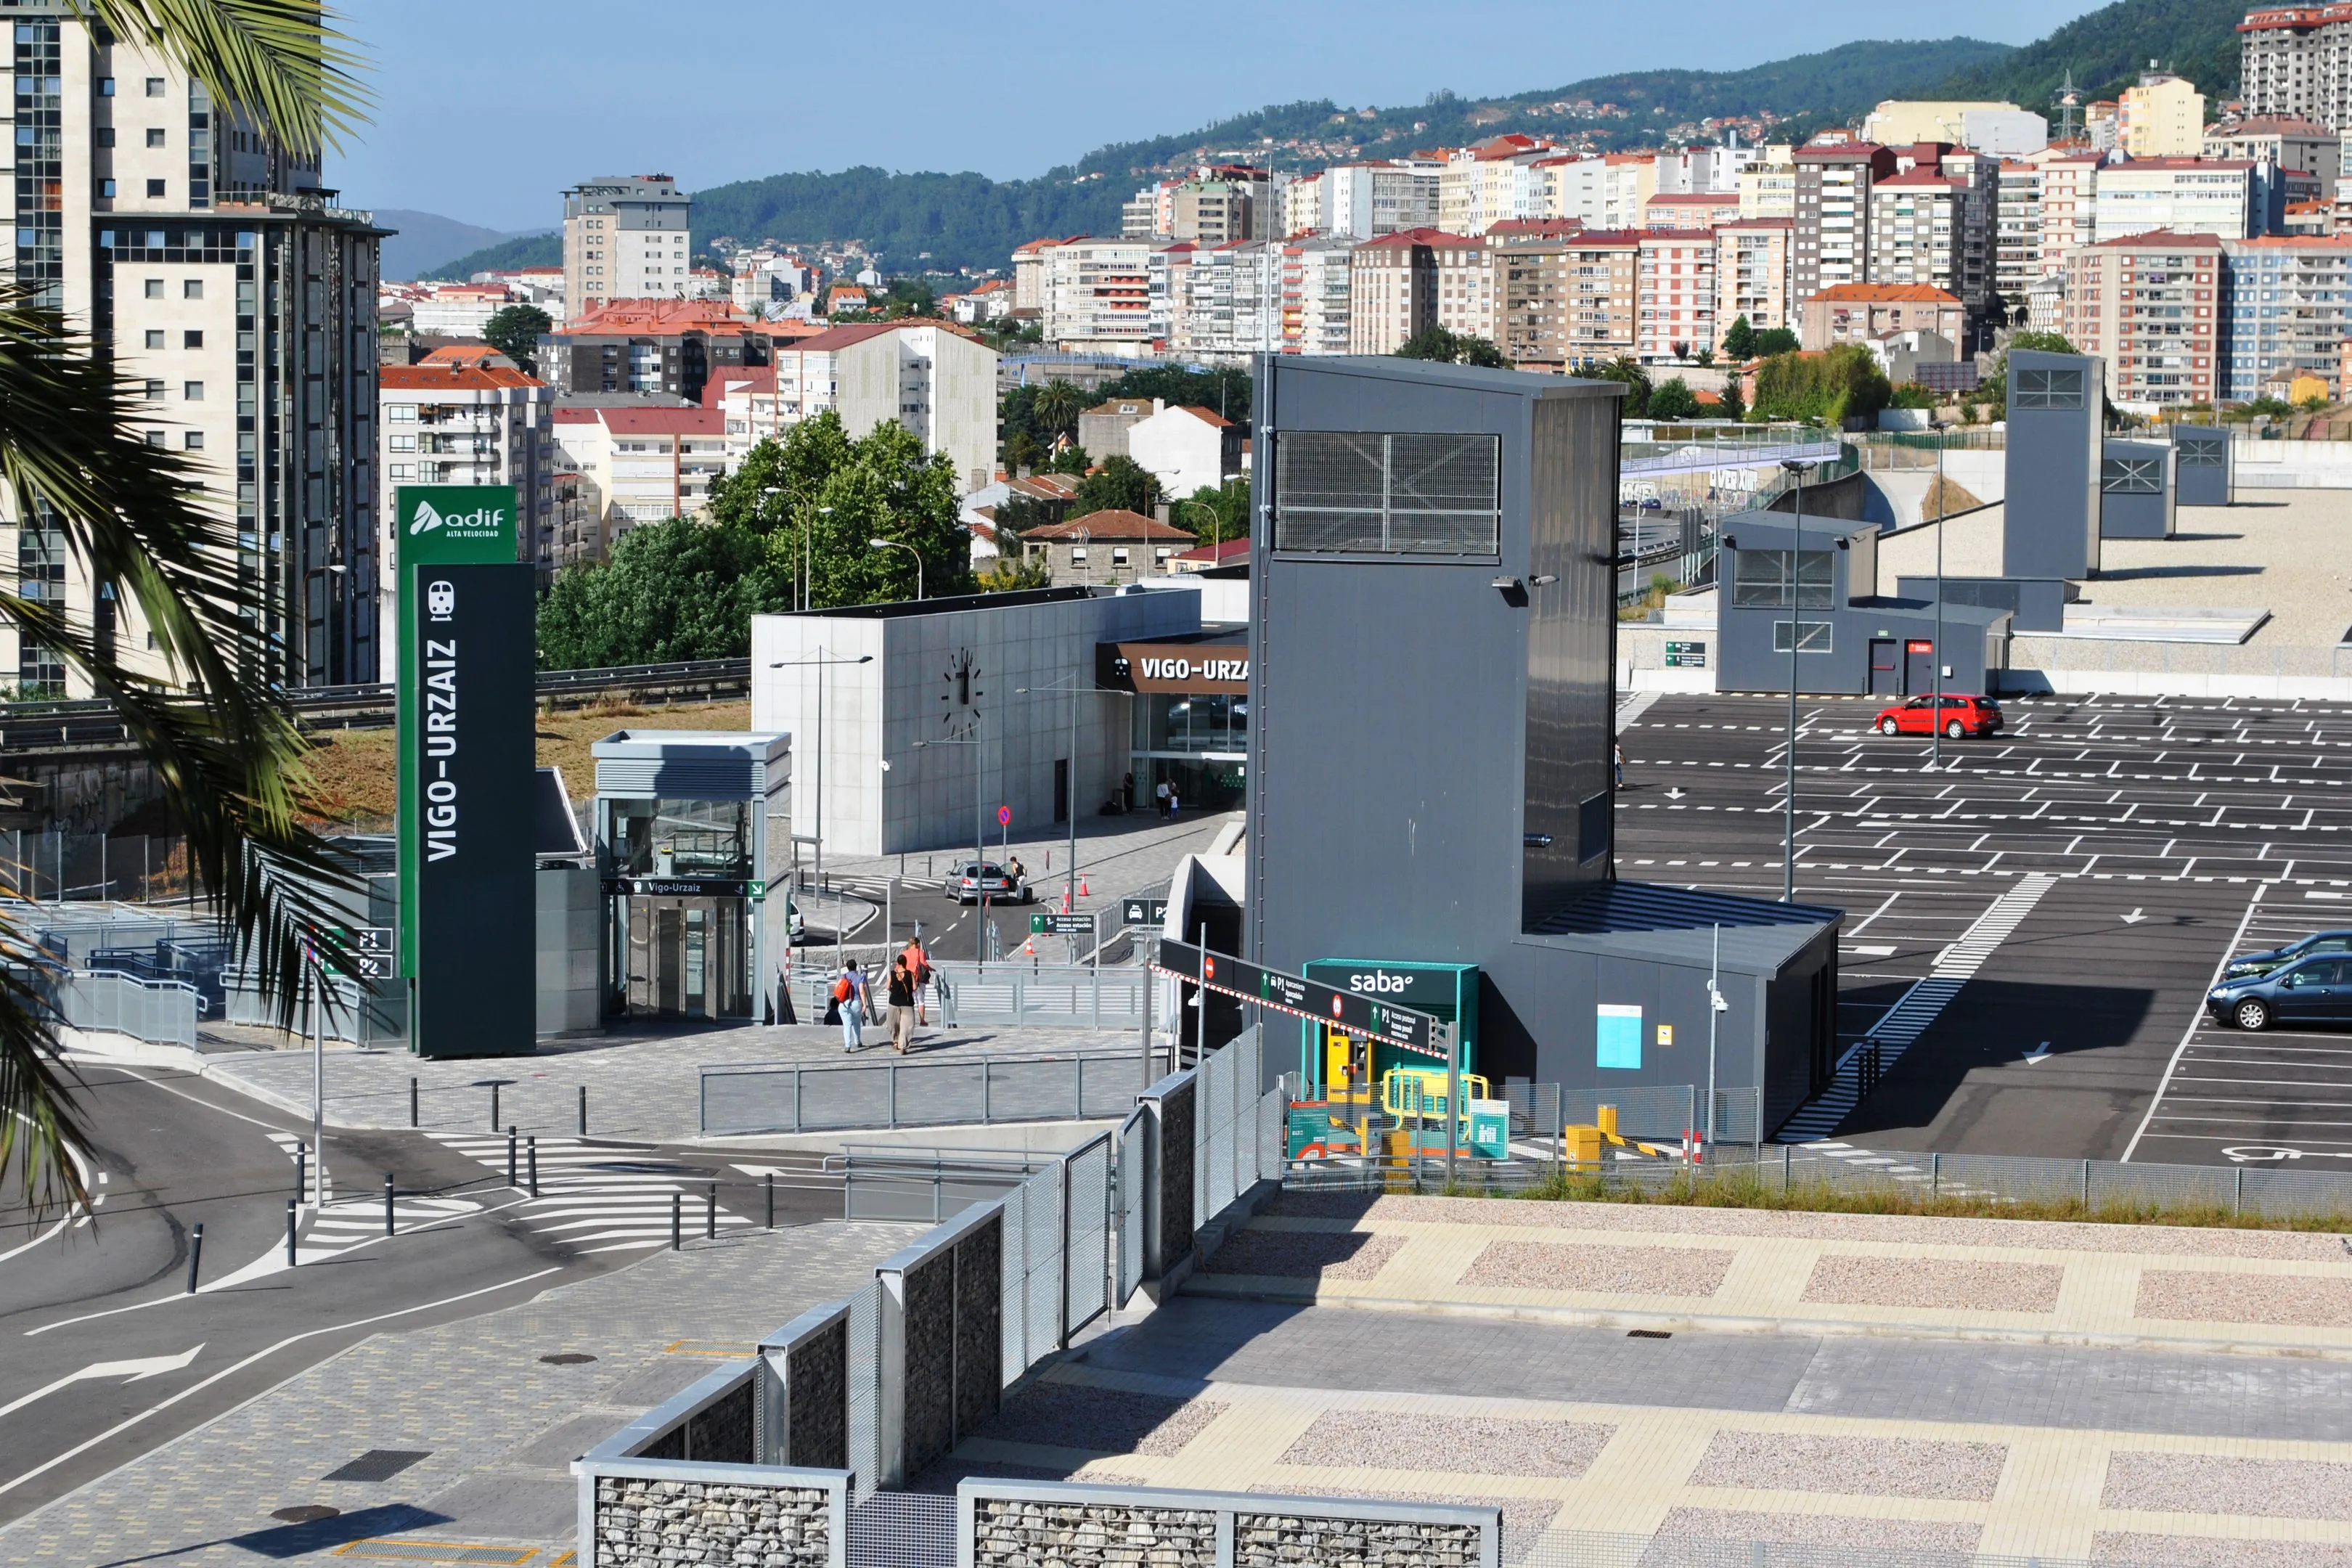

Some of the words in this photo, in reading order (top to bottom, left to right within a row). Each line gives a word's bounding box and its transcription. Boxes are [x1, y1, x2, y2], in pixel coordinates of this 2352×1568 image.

[445, 508, 505, 527] adif
[427, 640, 457, 862] VIGO-URZAIZ
[648, 882, 701, 893] Vigo-Urzaiz
[359, 931, 378, 947] P1
[1277, 976, 1285, 992] P1
[1381, 1008, 1389, 1024] P1
